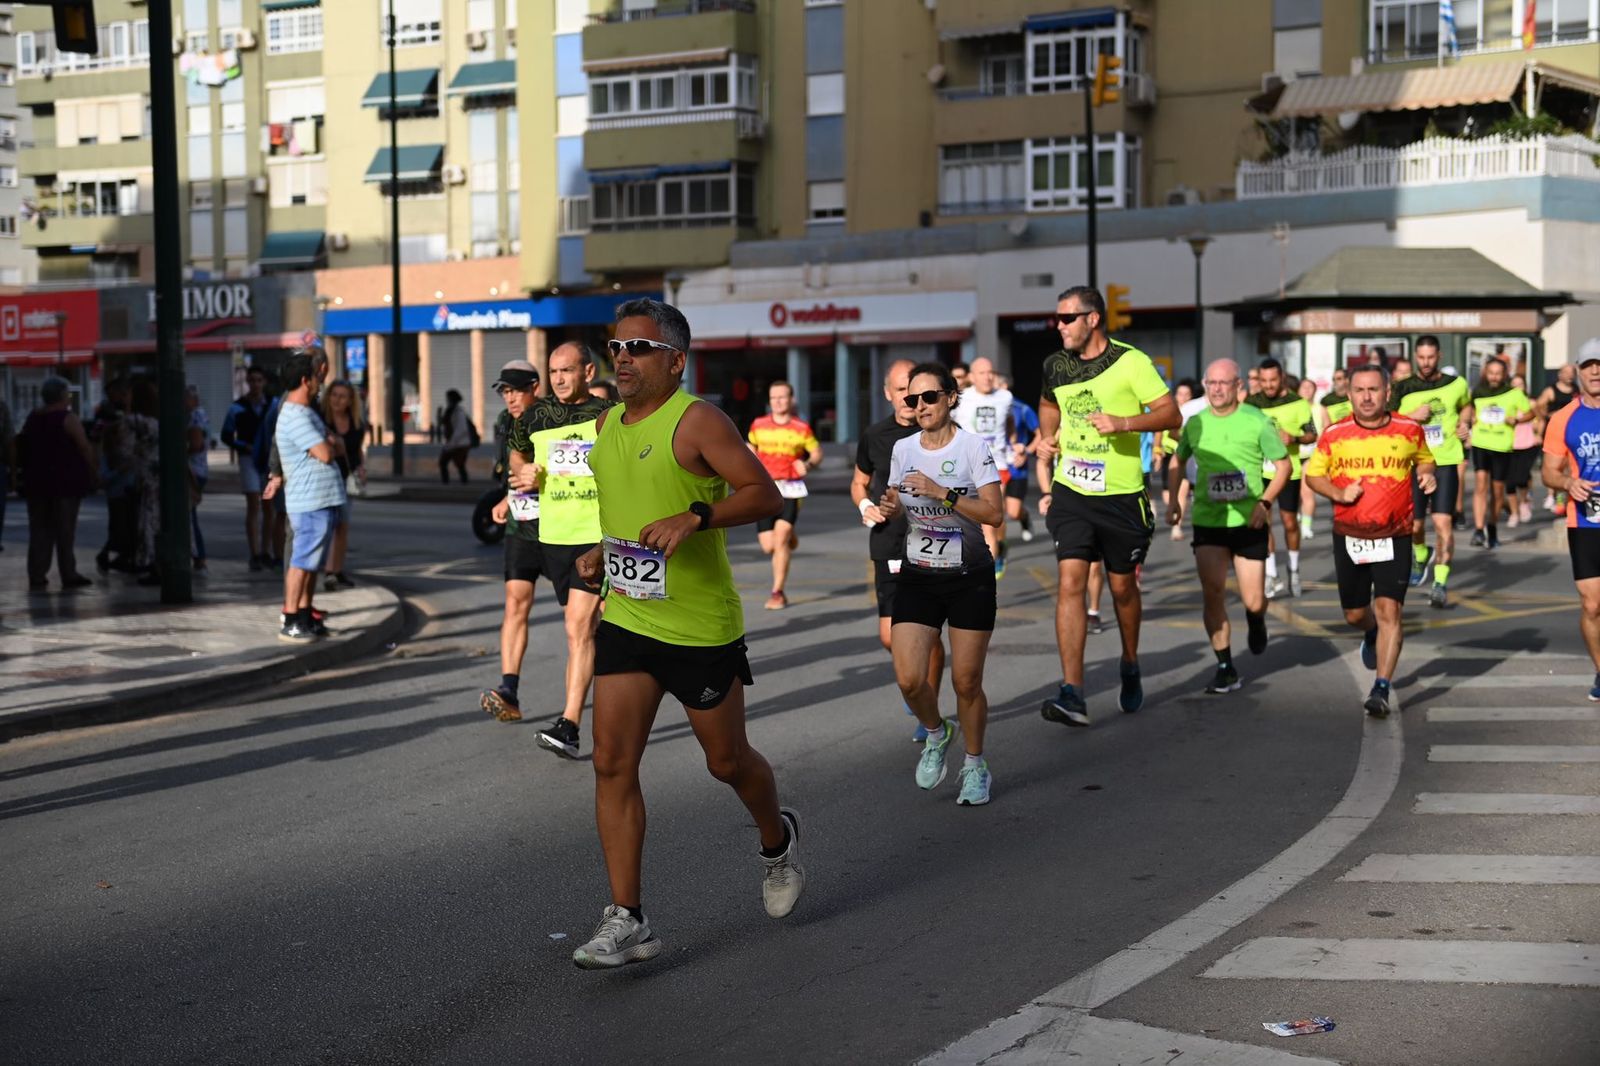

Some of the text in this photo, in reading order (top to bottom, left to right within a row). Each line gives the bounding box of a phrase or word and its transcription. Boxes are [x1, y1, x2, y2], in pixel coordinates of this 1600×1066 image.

[146, 285, 252, 322] IMOR
[1067, 465, 1103, 482] 442
[1212, 476, 1246, 492] 483
[906, 505, 954, 517] PRIMOR
[920, 536, 950, 555] 27
[608, 552, 661, 583] 582
